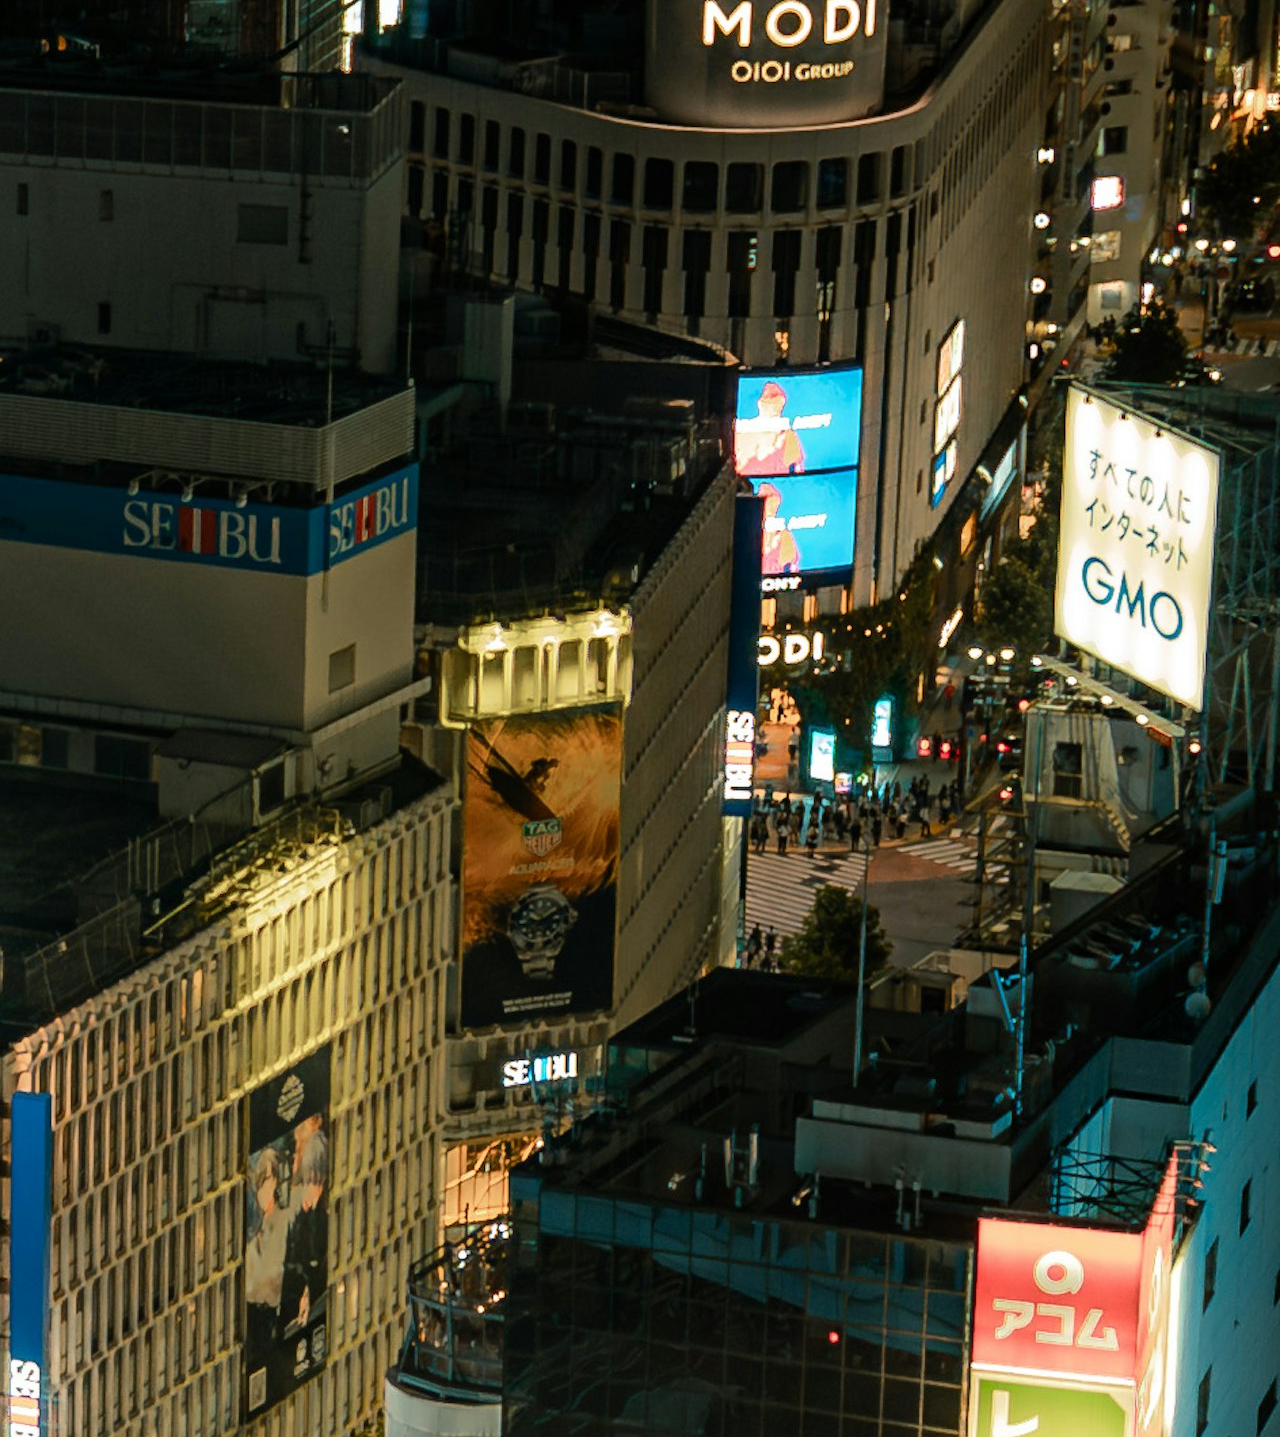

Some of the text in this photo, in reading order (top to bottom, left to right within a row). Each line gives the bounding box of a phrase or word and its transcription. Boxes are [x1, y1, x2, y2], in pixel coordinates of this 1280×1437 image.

[329, 476, 409, 557] SEIBU
[1090, 449, 1192, 524] すべての人に
[123, 500, 281, 564] SEIBU
[1084, 496, 1188, 571] インターネット
[760, 575, 802, 593] ONY
[1081, 556, 1184, 641] GMO
[758, 631, 824, 667] ODI
[724, 709, 756, 800] SEIBU
[524, 820, 560, 835] TAG
[992, 1298, 1119, 1352] アコム
